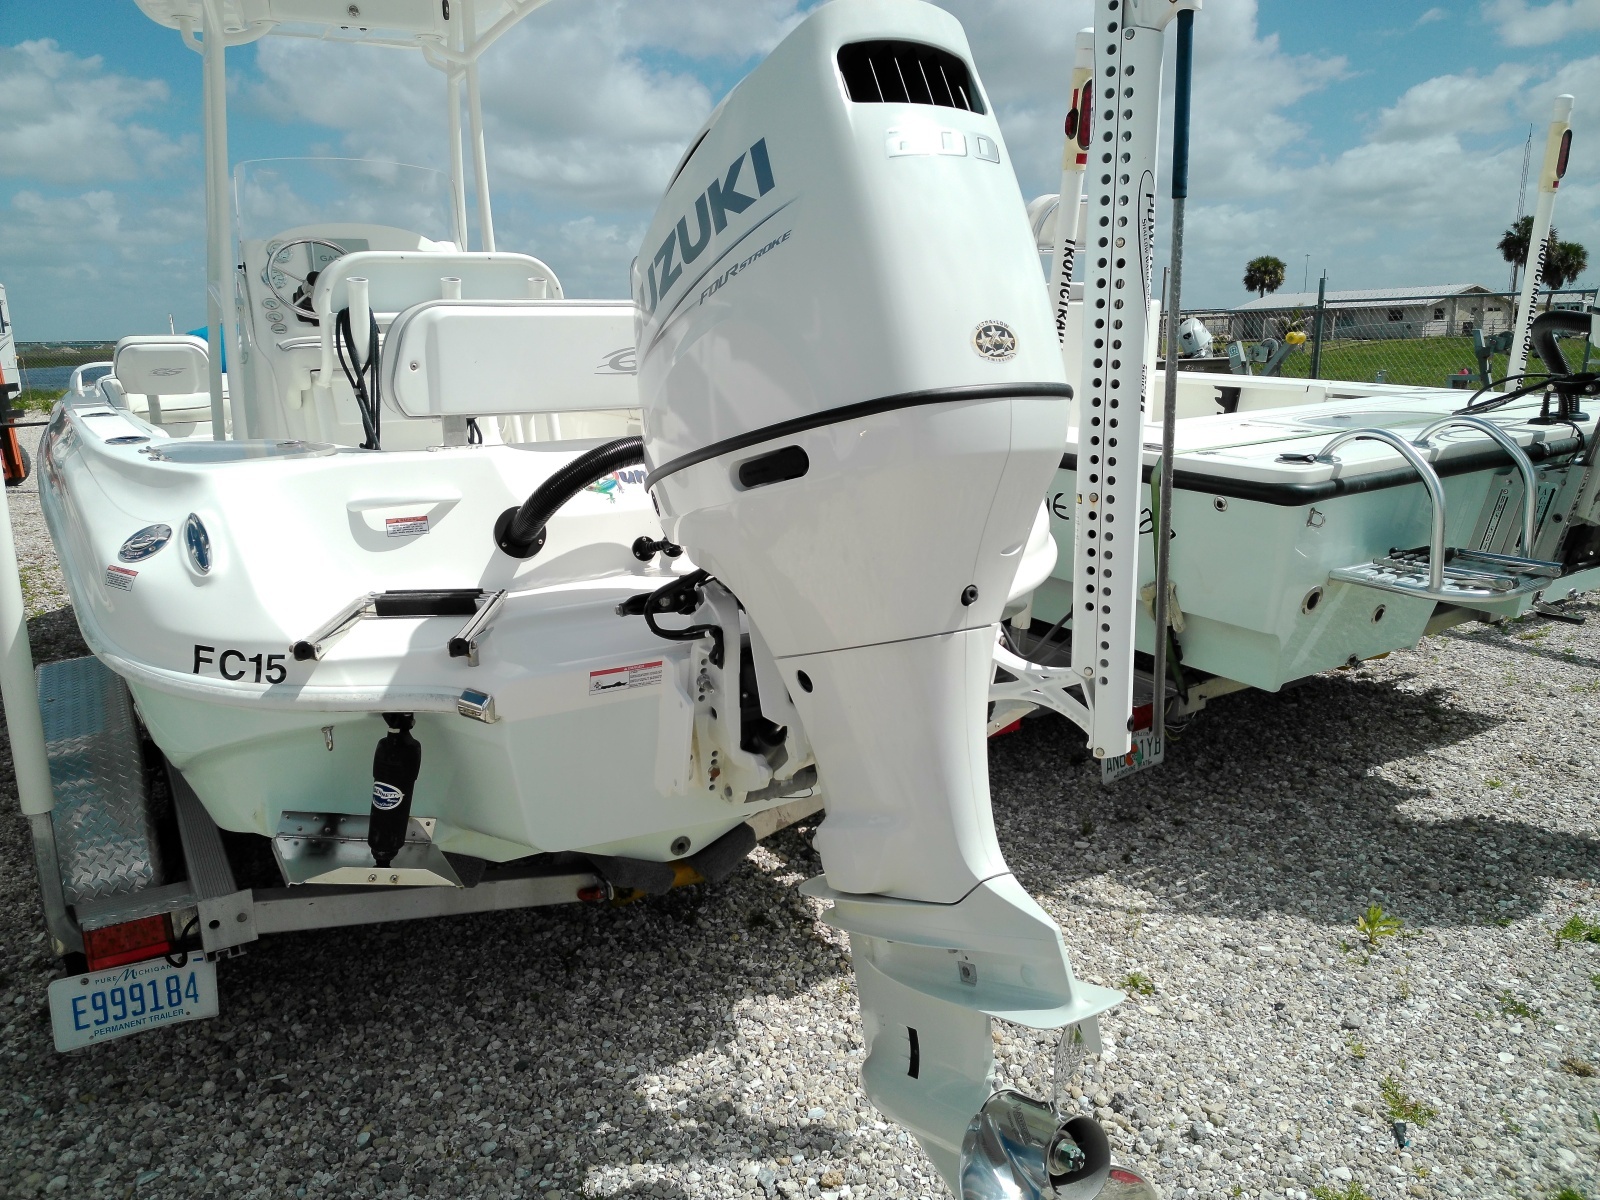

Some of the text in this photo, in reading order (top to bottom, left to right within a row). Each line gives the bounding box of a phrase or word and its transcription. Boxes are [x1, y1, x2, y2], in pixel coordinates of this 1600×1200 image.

[637, 136, 775, 328] UZUKI
[193, 644, 287, 685] FC15
[95, 964, 173, 986] PURE MICHIGAN
[72, 971, 199, 1031] E999184
[94, 1008, 184, 1037] PERMANENT TRAILER
